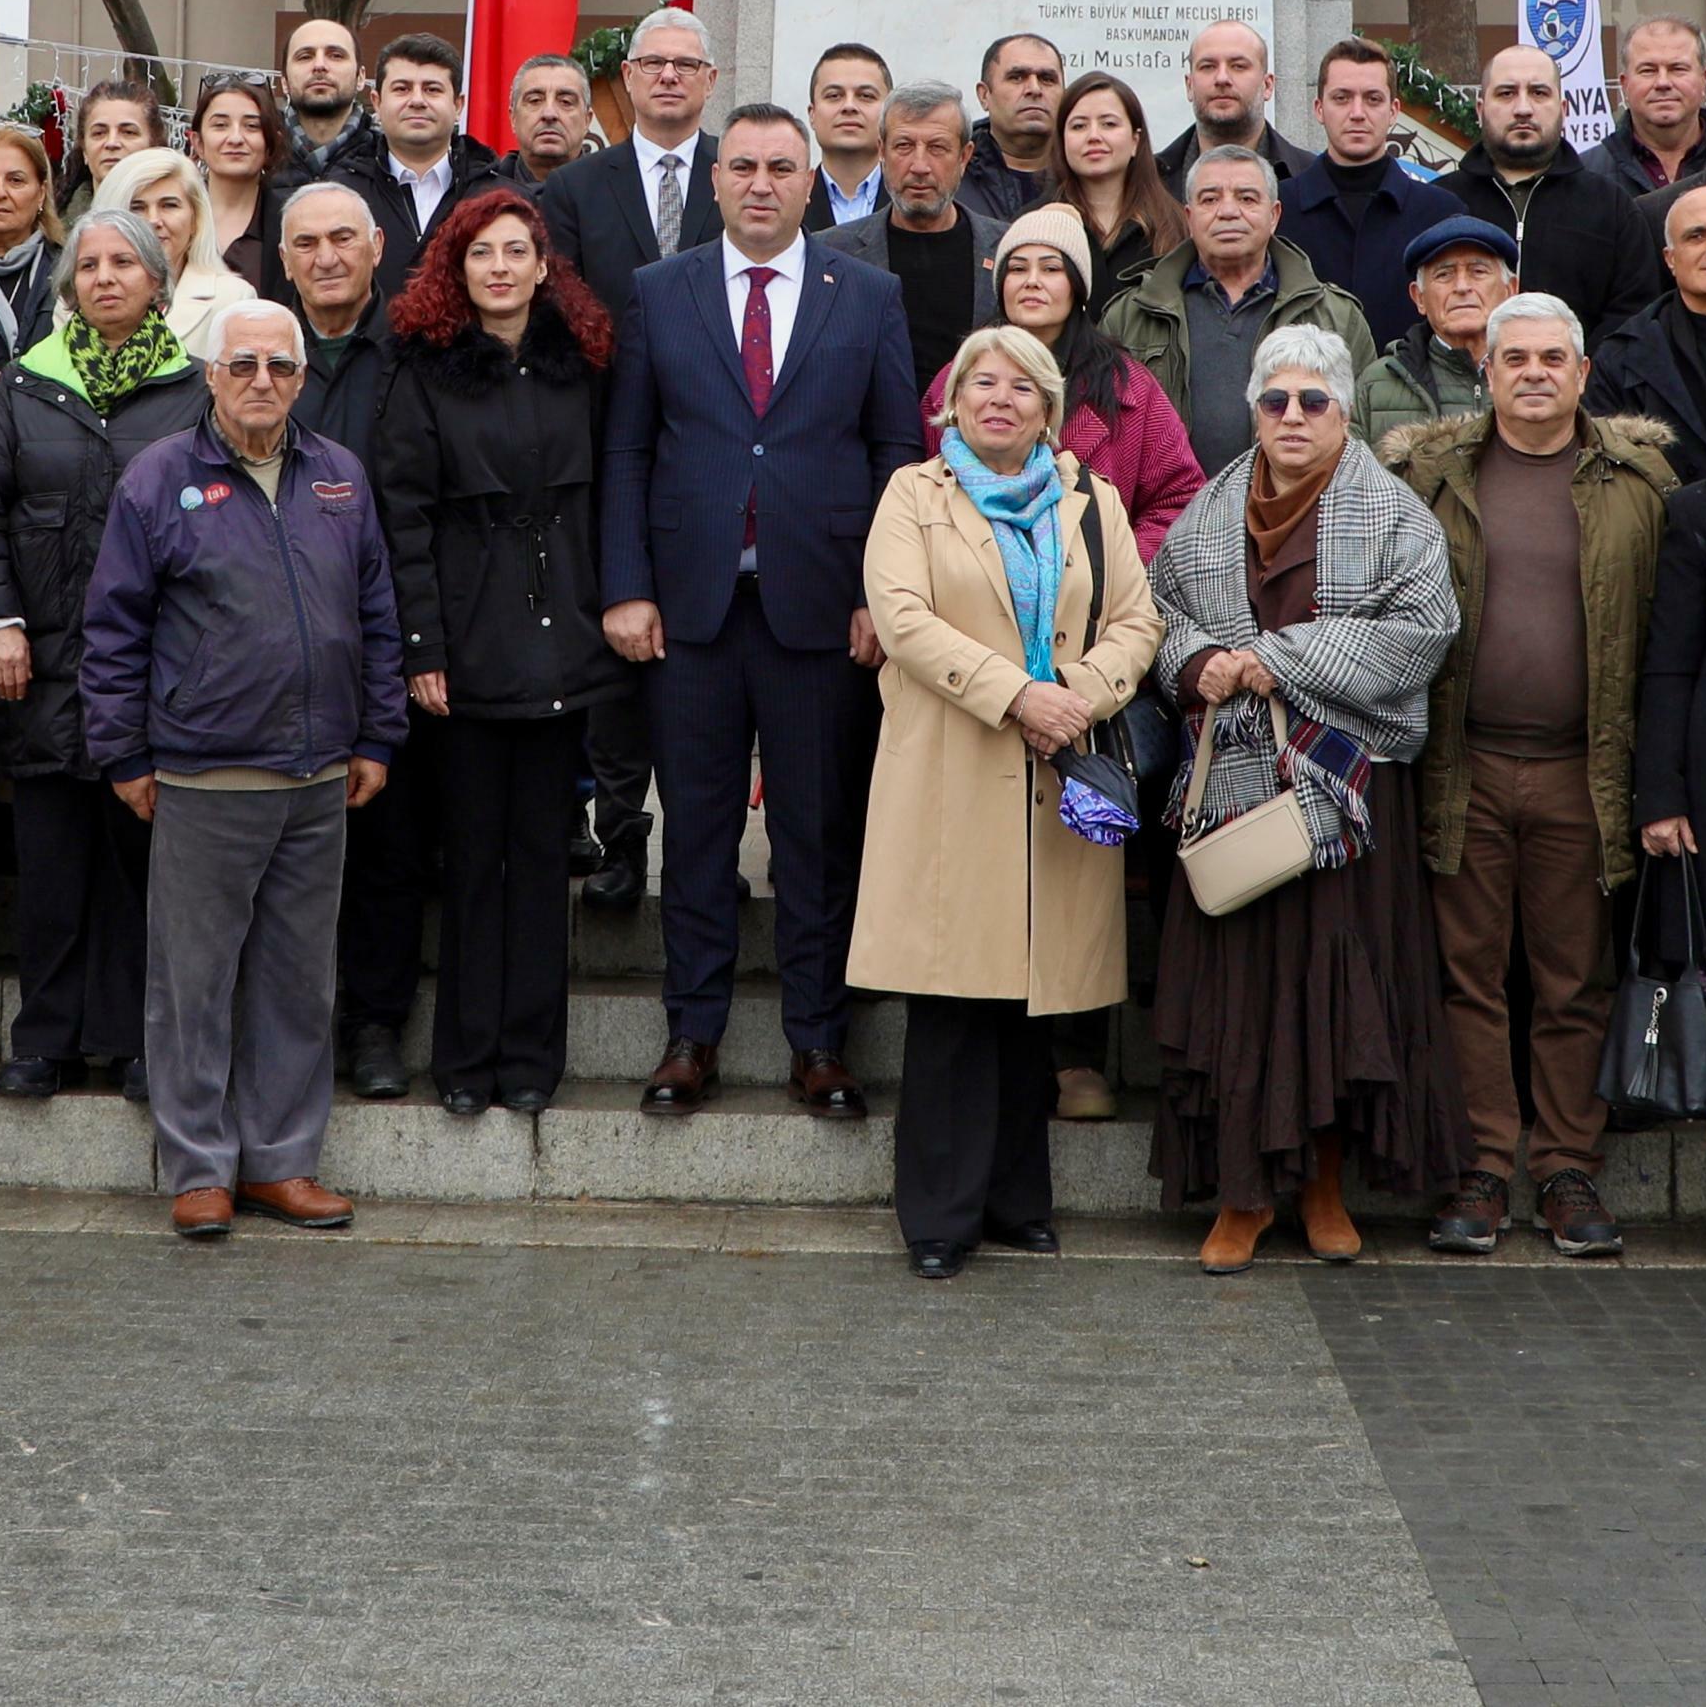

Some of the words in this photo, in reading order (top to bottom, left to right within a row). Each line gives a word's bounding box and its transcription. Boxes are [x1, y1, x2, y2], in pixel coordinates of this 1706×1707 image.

[1038, 4, 1082, 19] TÜRKİYE
[1090, 5, 1126, 19] BÜYÜK
[1094, 50, 1171, 68] Mustafa
